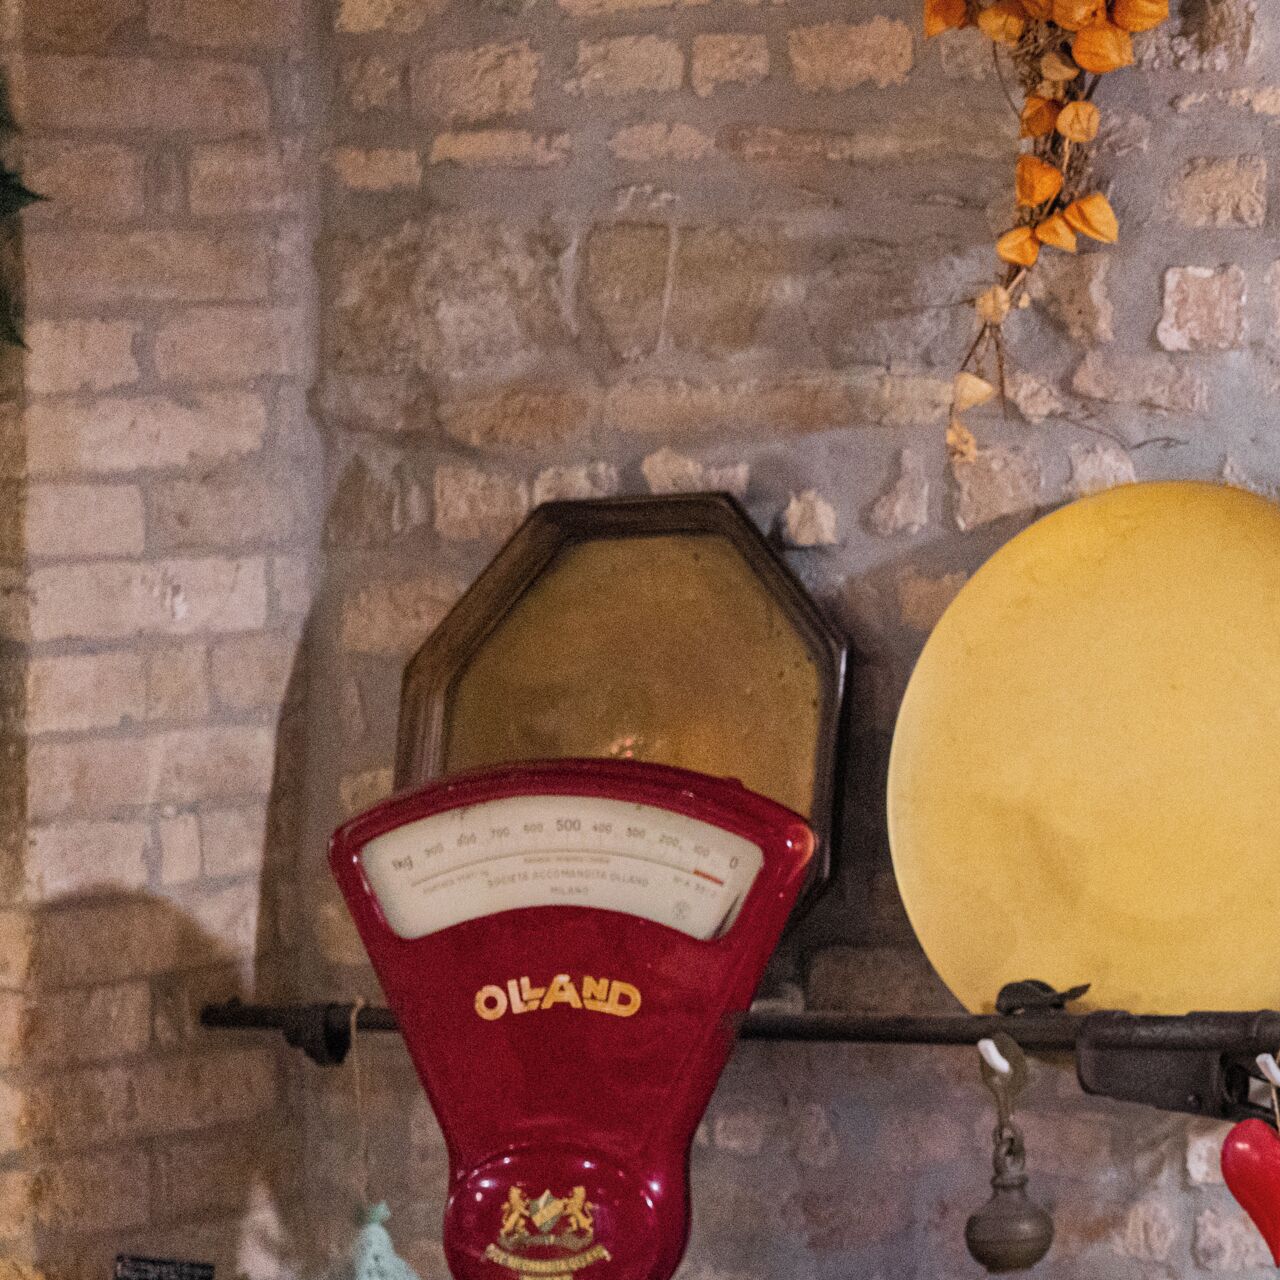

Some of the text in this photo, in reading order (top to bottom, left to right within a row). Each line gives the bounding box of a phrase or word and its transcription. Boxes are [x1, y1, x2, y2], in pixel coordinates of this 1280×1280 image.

[555, 818, 582, 833] 500
[728, 855, 740, 871] 0
[474, 973, 643, 1021] OLLAND
